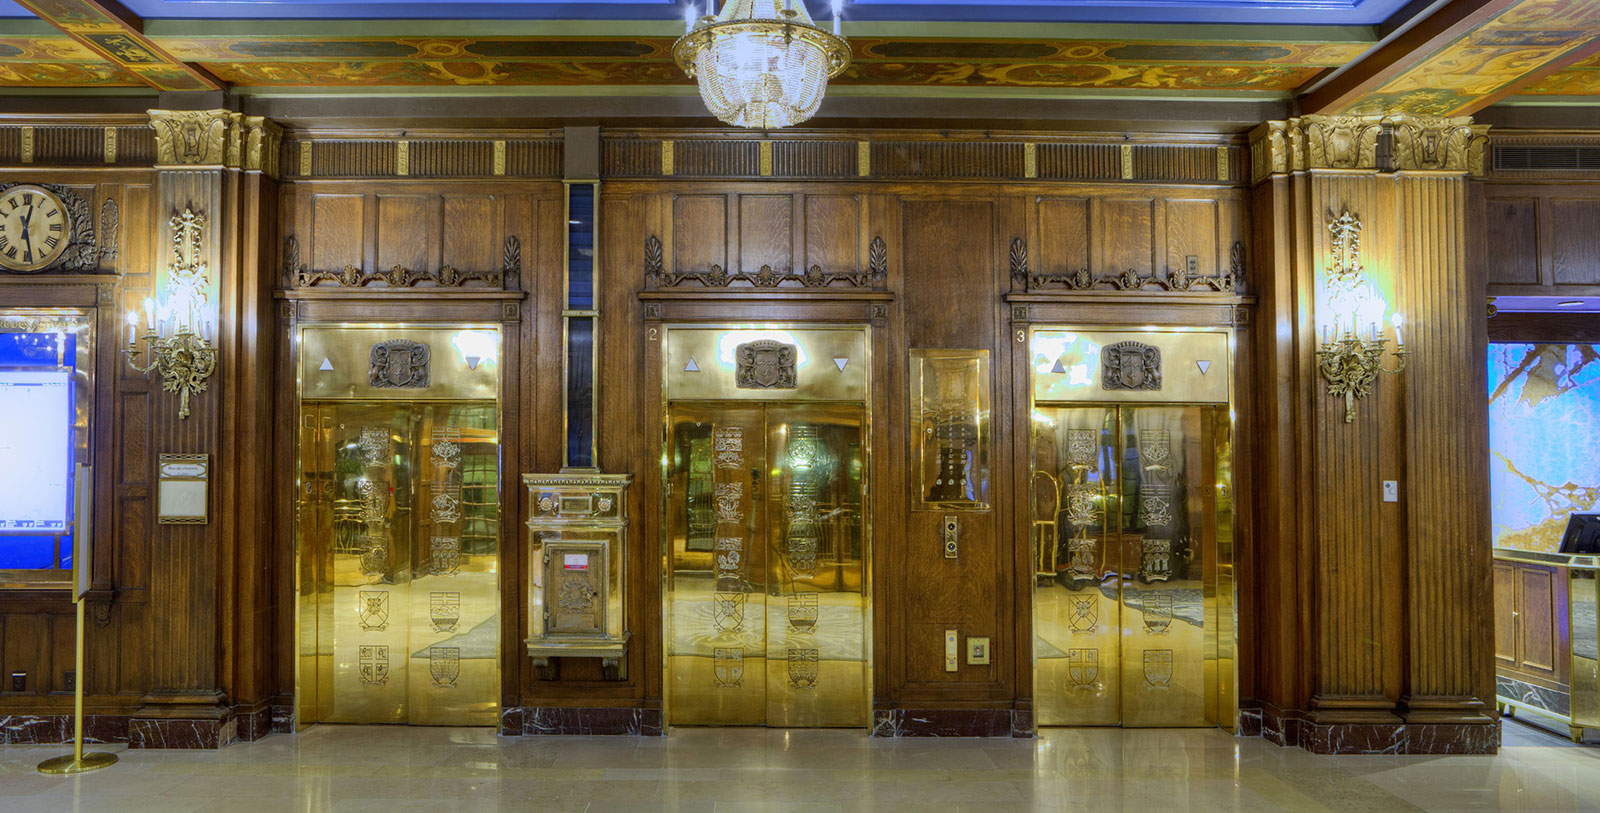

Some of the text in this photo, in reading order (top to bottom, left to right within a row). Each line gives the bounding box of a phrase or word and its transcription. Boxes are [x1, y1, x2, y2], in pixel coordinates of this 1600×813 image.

[8, 198, 18, 210] XI
[23, 193, 33, 206] XII
[37, 198, 46, 208] I
[46, 208, 58, 218] II
[38, 248, 46, 259] V
[649, 328, 657, 341] 2
[1016, 330, 1025, 343] 3
